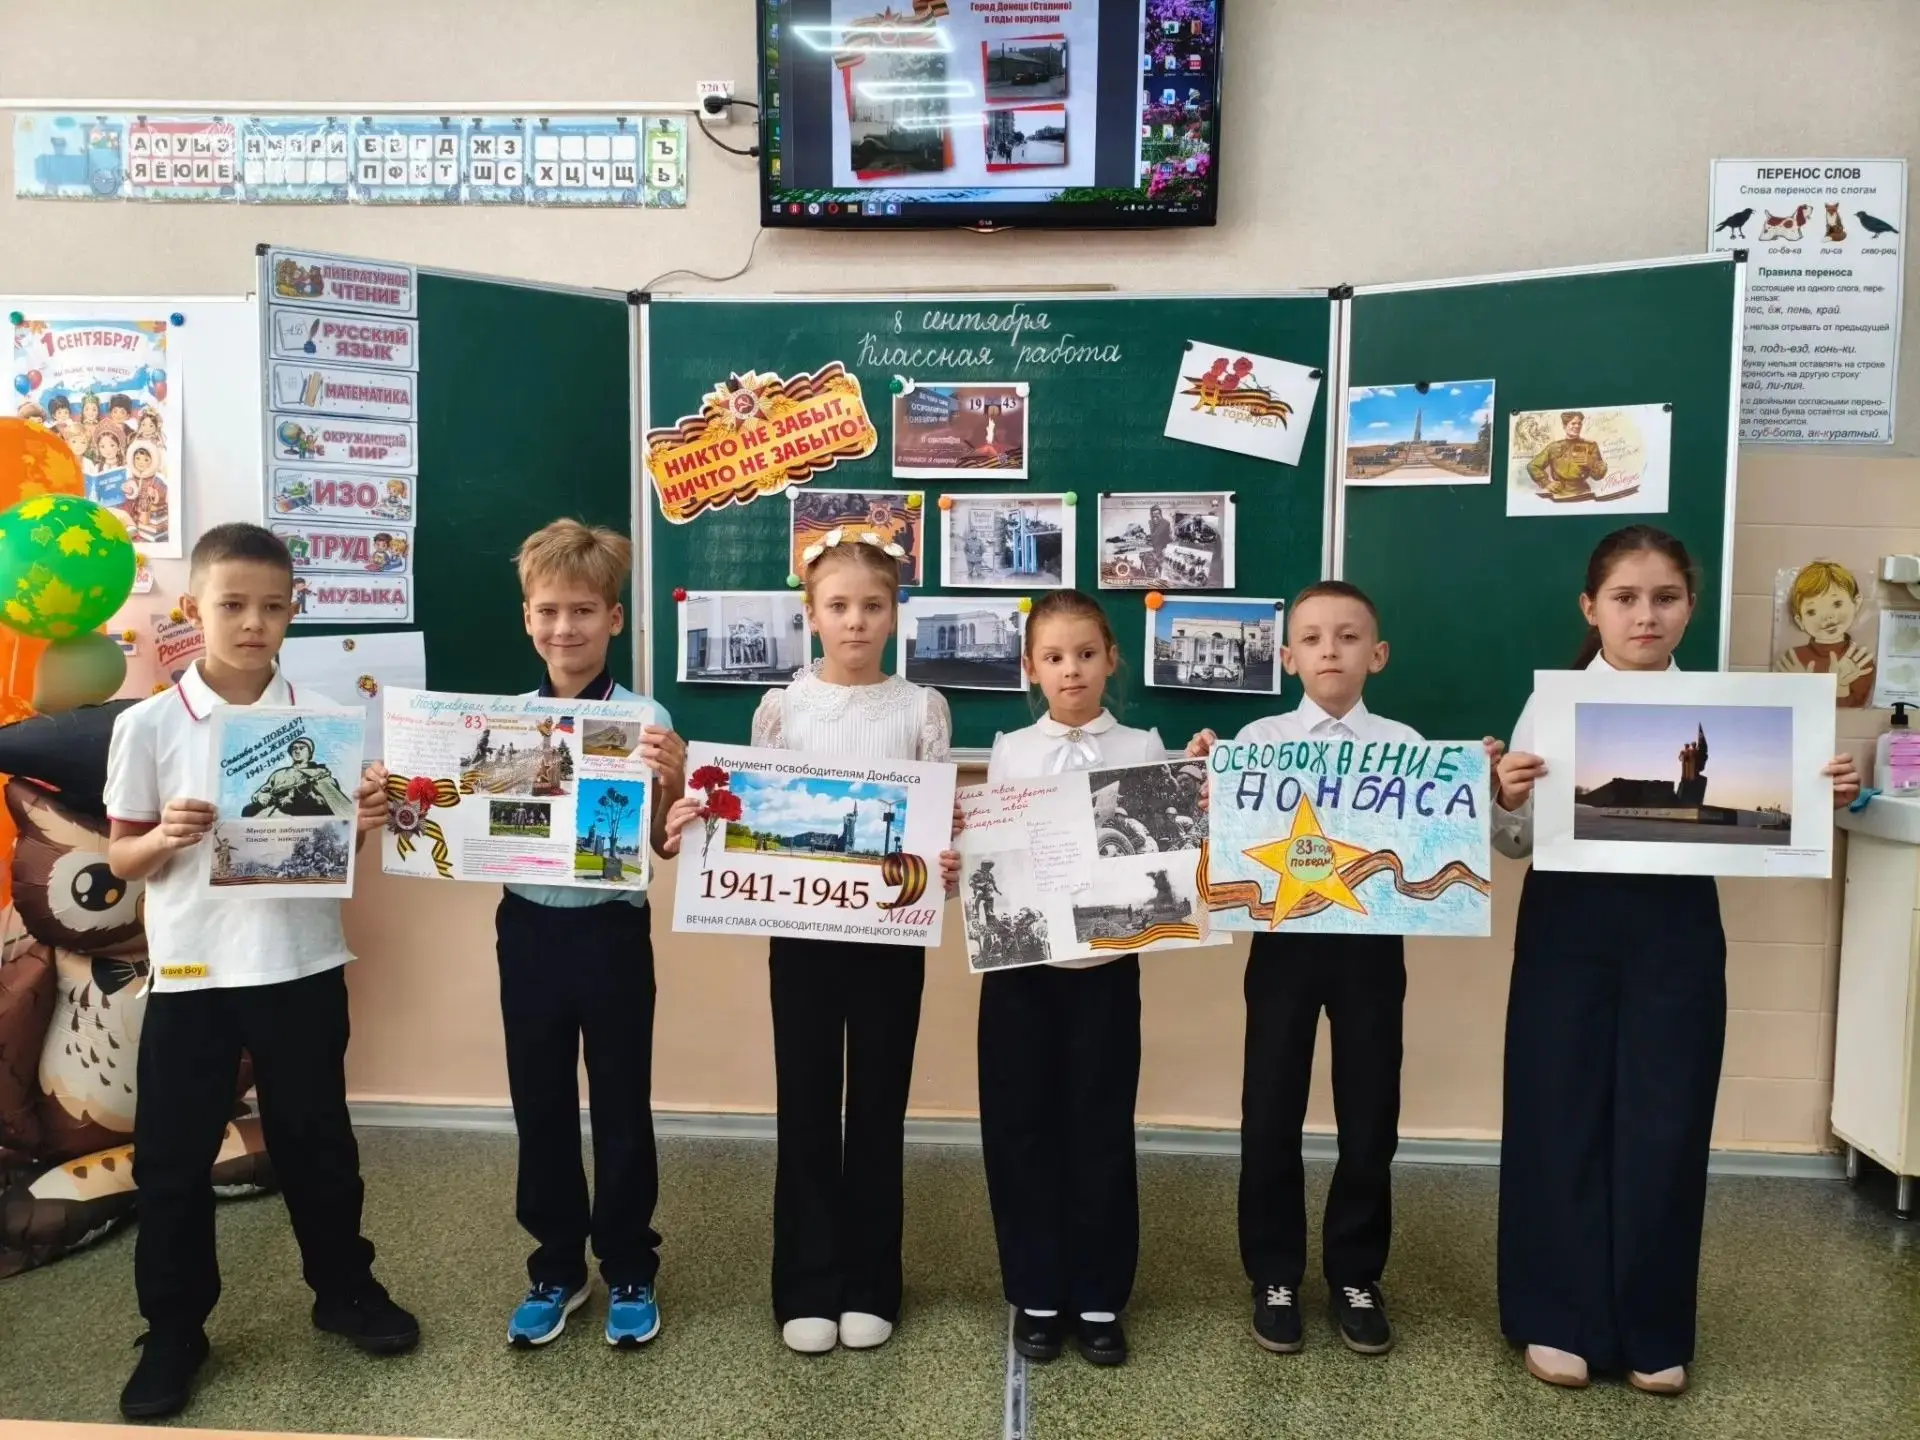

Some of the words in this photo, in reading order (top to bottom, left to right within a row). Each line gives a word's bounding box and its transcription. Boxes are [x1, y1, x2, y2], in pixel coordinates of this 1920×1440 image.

[970, 2, 996, 12] Город
[991, 15, 1013, 25] годы
[701, 83, 719, 92] 220
[1756, 167, 1821, 180] ПЕРЕНОС
[1824, 167, 1861, 180] СЛОВ
[1739, 184, 1771, 195] Слова
[1774, 186, 1823, 196] переноси
[1825, 186, 1838, 194] по
[1841, 186, 1877, 195] слогам
[323, 265, 408, 288] ЛИТЕРАТУРНОЕ
[1758, 267, 1802, 278] Правила
[1805, 268, 1853, 278] переноса
[330, 282, 401, 304] ЧТЕНИЕ
[1751, 285, 1795, 293] состоящее
[323, 322, 408, 346] РУССКИЙ
[894, 309, 903, 334] 8
[922, 302, 1052, 347] сентября
[1834, 323, 1890, 332] предыдущей
[40, 331, 55, 357] 1
[57, 330, 140, 352] СЕНТЯБРЯ!
[336, 341, 393, 361] ЯЗЫК
[856, 331, 995, 368] Классная
[1013, 333, 1122, 375] работа
[1799, 371, 1829, 380] другую
[325, 382, 410, 405] МАТЕМАТИКА
[969, 398, 983, 410] 19
[1002, 396, 1016, 409] 43
[322, 430, 407, 448] ОКРУЖАЮЩИЙ
[663, 439, 738, 478] НИКТО
[741, 425, 771, 449] НЕ
[772, 397, 852, 438] ЗАБЫТ,
[348, 446, 388, 460] МИР
[662, 464, 736, 504] НИЧТО
[739, 452, 769, 476] НЕ
[770, 414, 867, 464] ЗАБЫТО!
[313, 478, 378, 509] ИЗО
[308, 533, 371, 563] ТРУД
[317, 587, 406, 604] МУЗЫКА
[465, 715, 482, 730] 83
[220, 746, 253, 768] Спасибо
[253, 742, 263, 751] за
[261, 716, 303, 745] ПОБЕДУ!
[226, 755, 259, 777] Спасибо
[259, 750, 269, 758] за
[268, 726, 306, 754] ЖИЗНЬ!
[245, 751, 286, 780] 1941-1945
[713, 755, 773, 774] Монумент
[775, 763, 865, 780] освободителям
[866, 768, 921, 785] Донбасса
[1235, 771, 1477, 820] ДОНБАСА
[1295, 839, 1313, 855] 83
[699, 869, 870, 910] 1941-1945
[686, 914, 724, 926] ВЕЧНАЯ
[725, 916, 757, 928] СЛАВА
[759, 918, 843, 935] ОСВОБОДИТЕЛЯМ
[844, 923, 901, 938] ДОНЕЦКОГО
[902, 927, 928, 938] КРАЯ!
[184, 965, 203, 975] Boy
